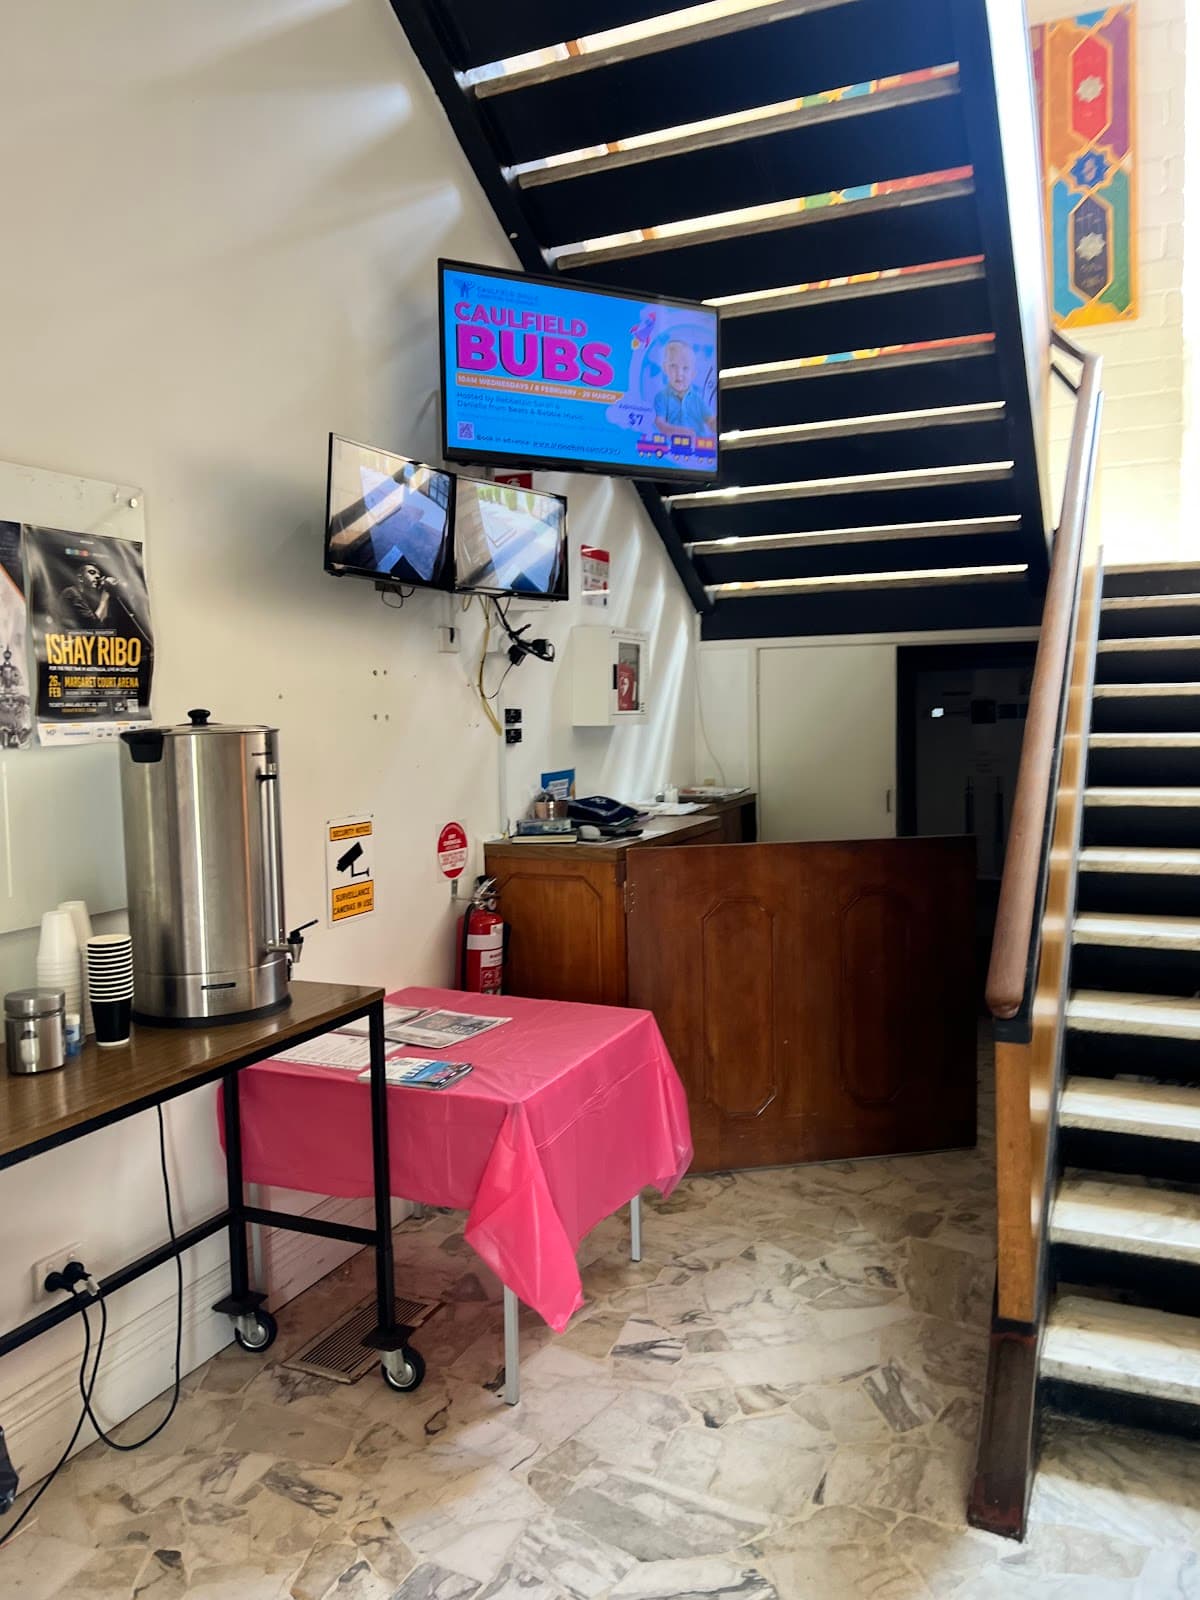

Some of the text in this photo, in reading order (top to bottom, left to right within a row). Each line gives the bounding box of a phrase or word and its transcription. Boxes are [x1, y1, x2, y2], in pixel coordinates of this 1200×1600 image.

[454, 301, 588, 337] CAULFIELD
[456, 324, 615, 387] BUBS
[479, 377, 528, 390] WEDNESDAYS
[629, 413, 643, 426] $7
[45, 633, 141, 667] ISHAY RIBO
[64, 676, 139, 688] MARGARET COURT ARENA
[48, 687, 61, 697] FEB
[336, 887, 370, 902] SURVEILLANCE
[357, 900, 362, 909] IN
[363, 898, 373, 907] USE
